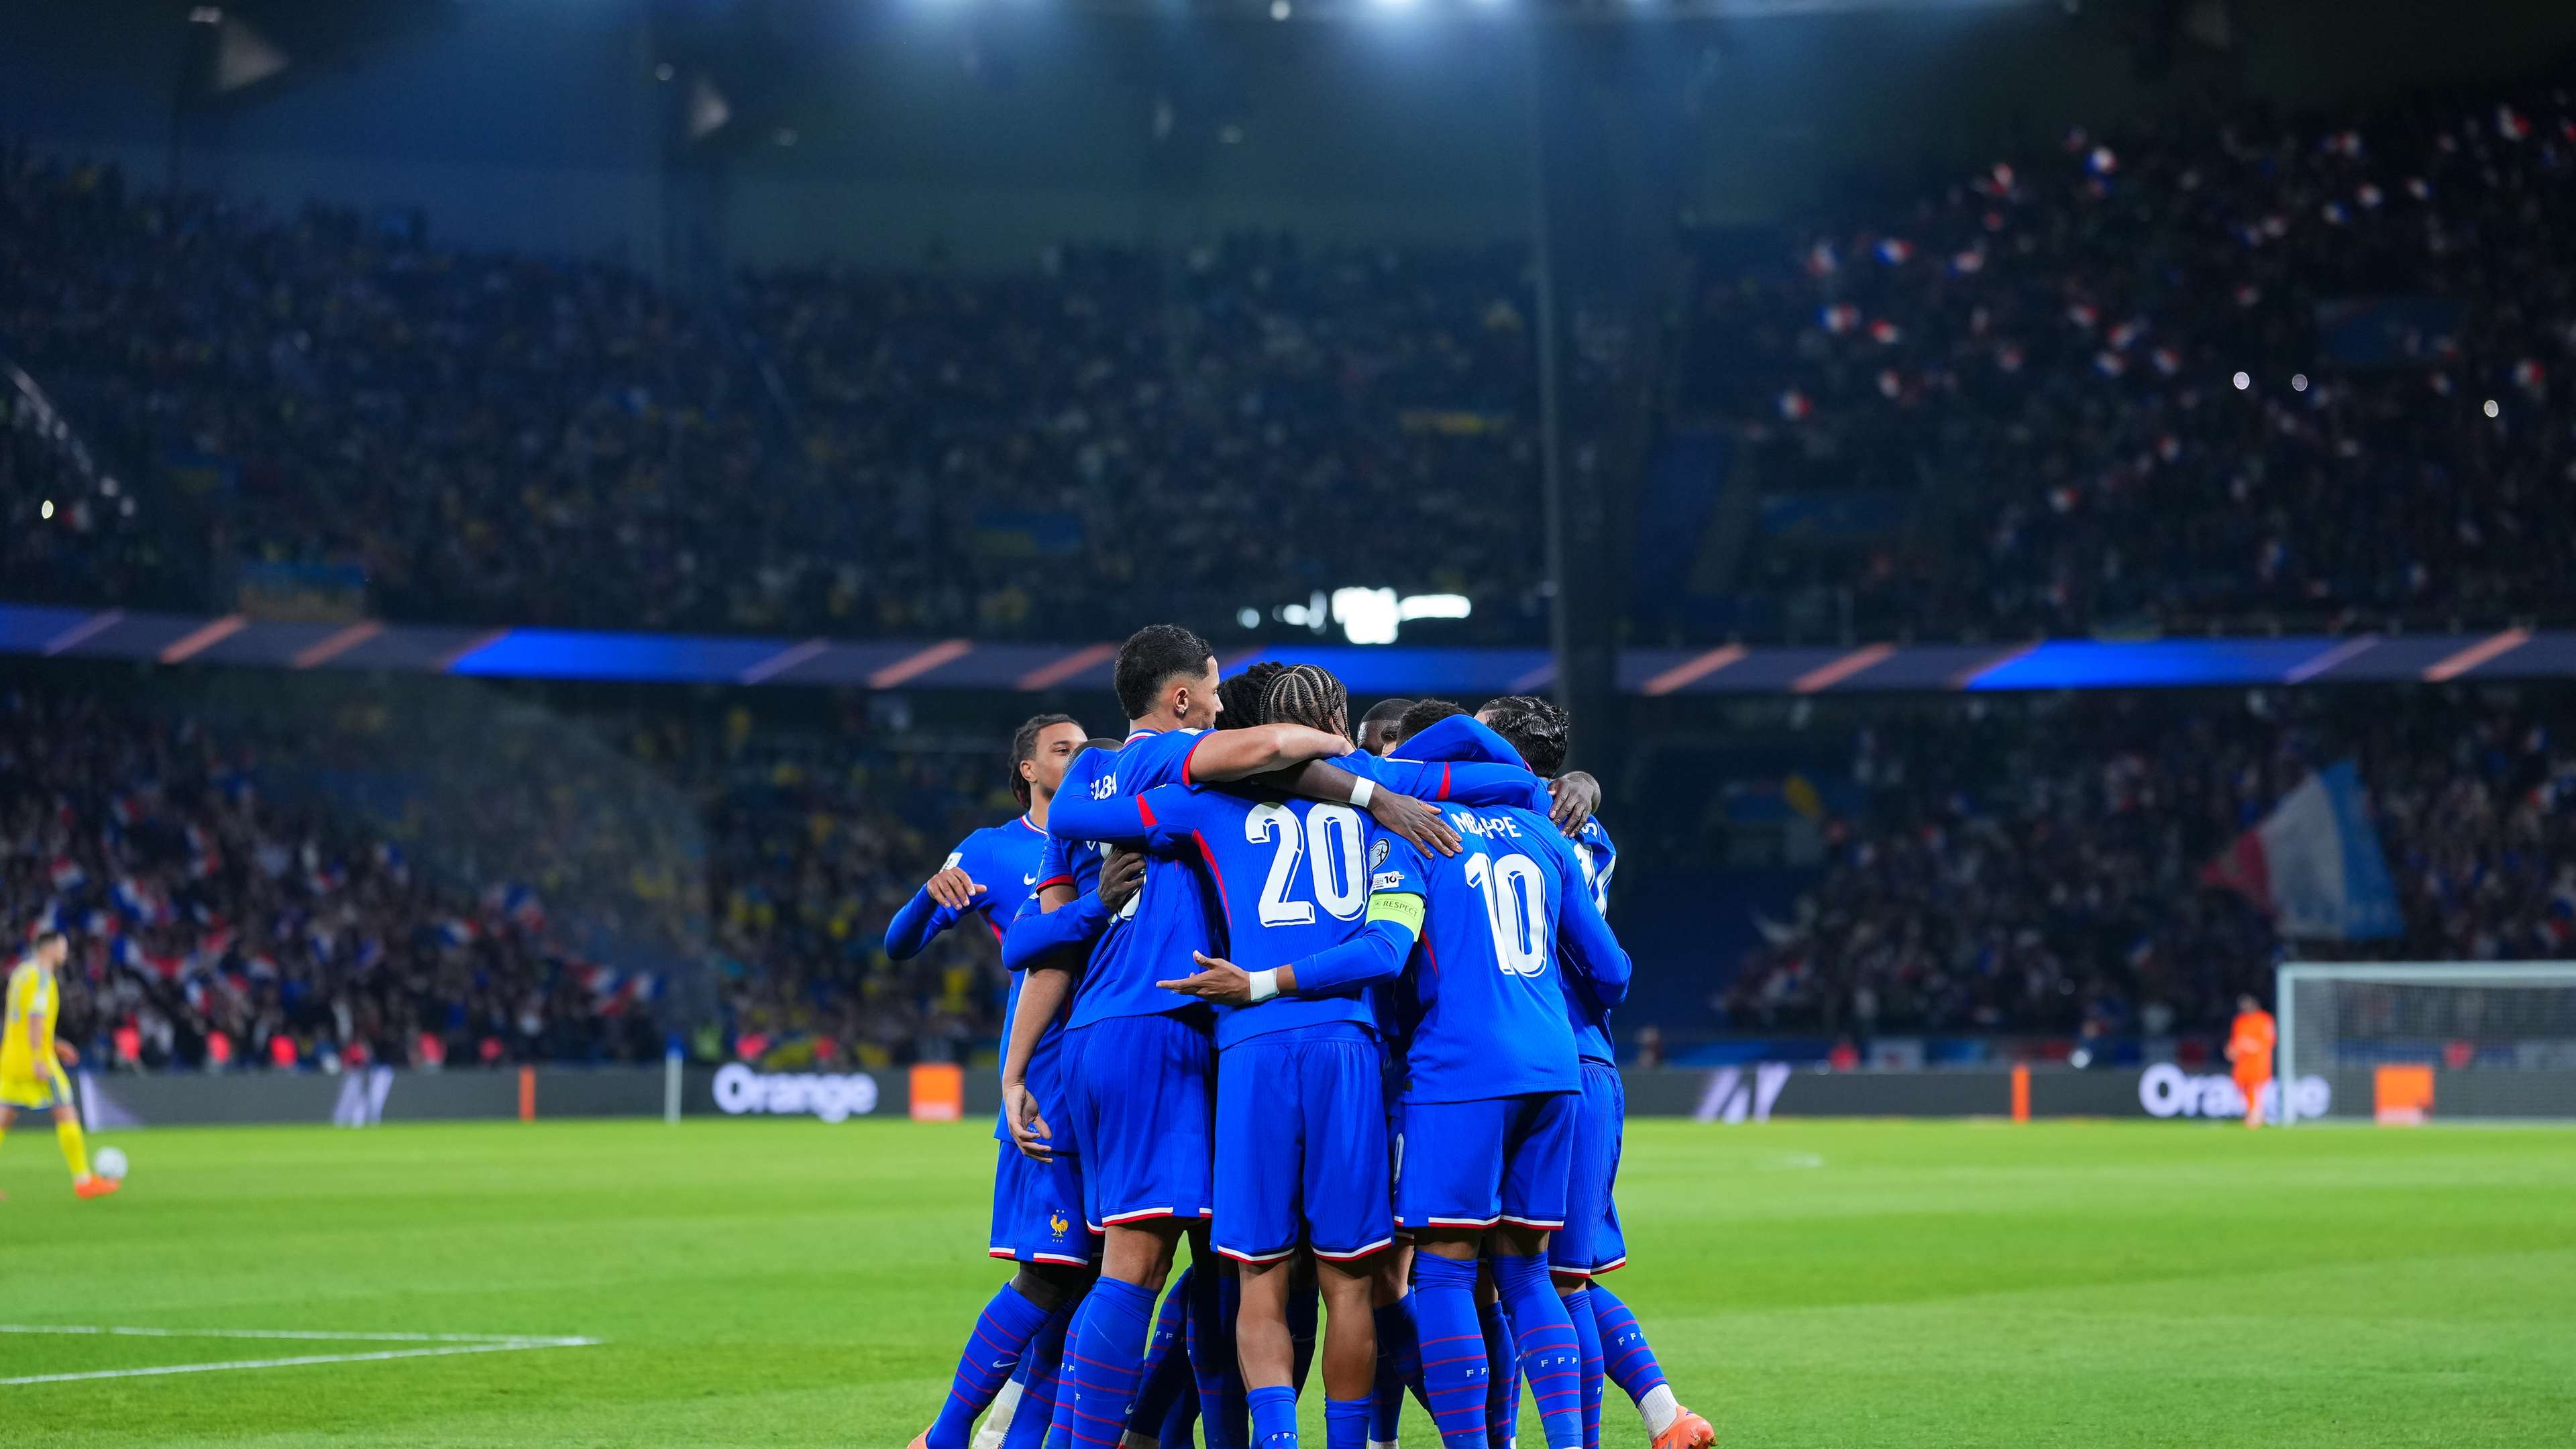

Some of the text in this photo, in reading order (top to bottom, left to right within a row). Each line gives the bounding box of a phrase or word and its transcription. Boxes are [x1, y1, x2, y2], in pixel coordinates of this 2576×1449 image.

[1245, 802, 1367, 928] 20
[1383, 900, 1417, 917] RESPECT
[1464, 852, 1548, 977] 10
[712, 1062, 879, 1124] Orange
[2138, 1062, 2332, 1126] Orae
